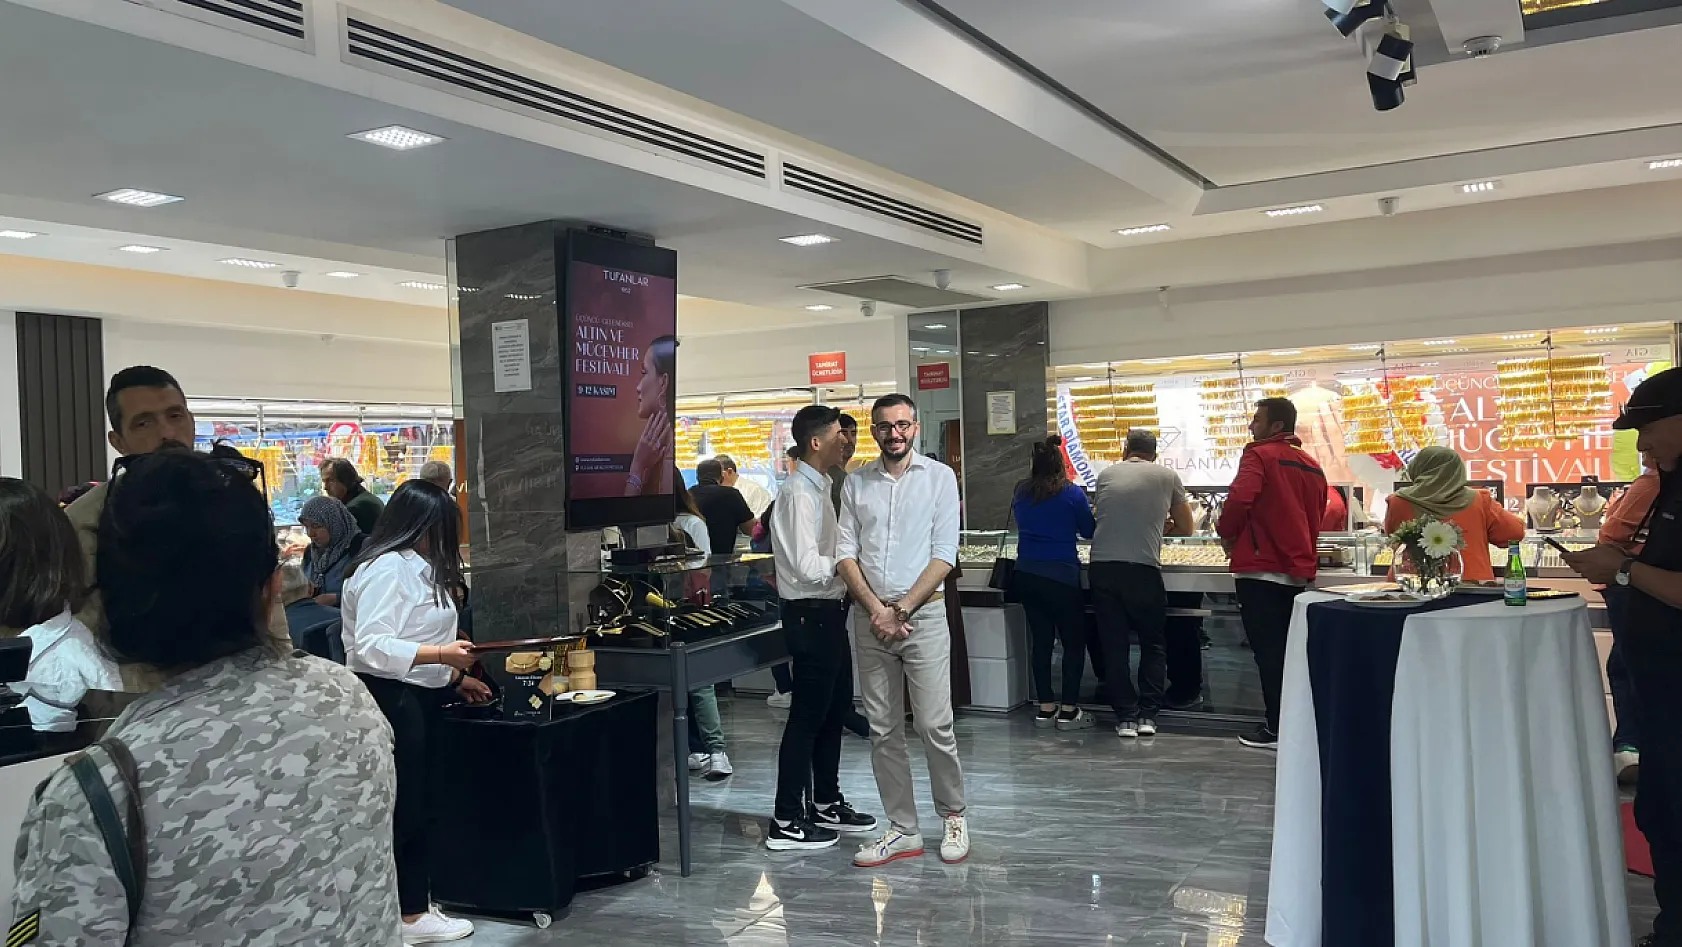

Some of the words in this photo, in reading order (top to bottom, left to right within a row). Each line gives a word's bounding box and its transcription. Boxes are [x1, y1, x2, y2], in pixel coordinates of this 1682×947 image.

[603, 269, 648, 287] TUFANLAR
[576, 325, 607, 341] ALTIN
[610, 328, 624, 343] VE
[576, 340, 639, 361] MÜCEVHER
[575, 358, 630, 377] FESTİVALİ
